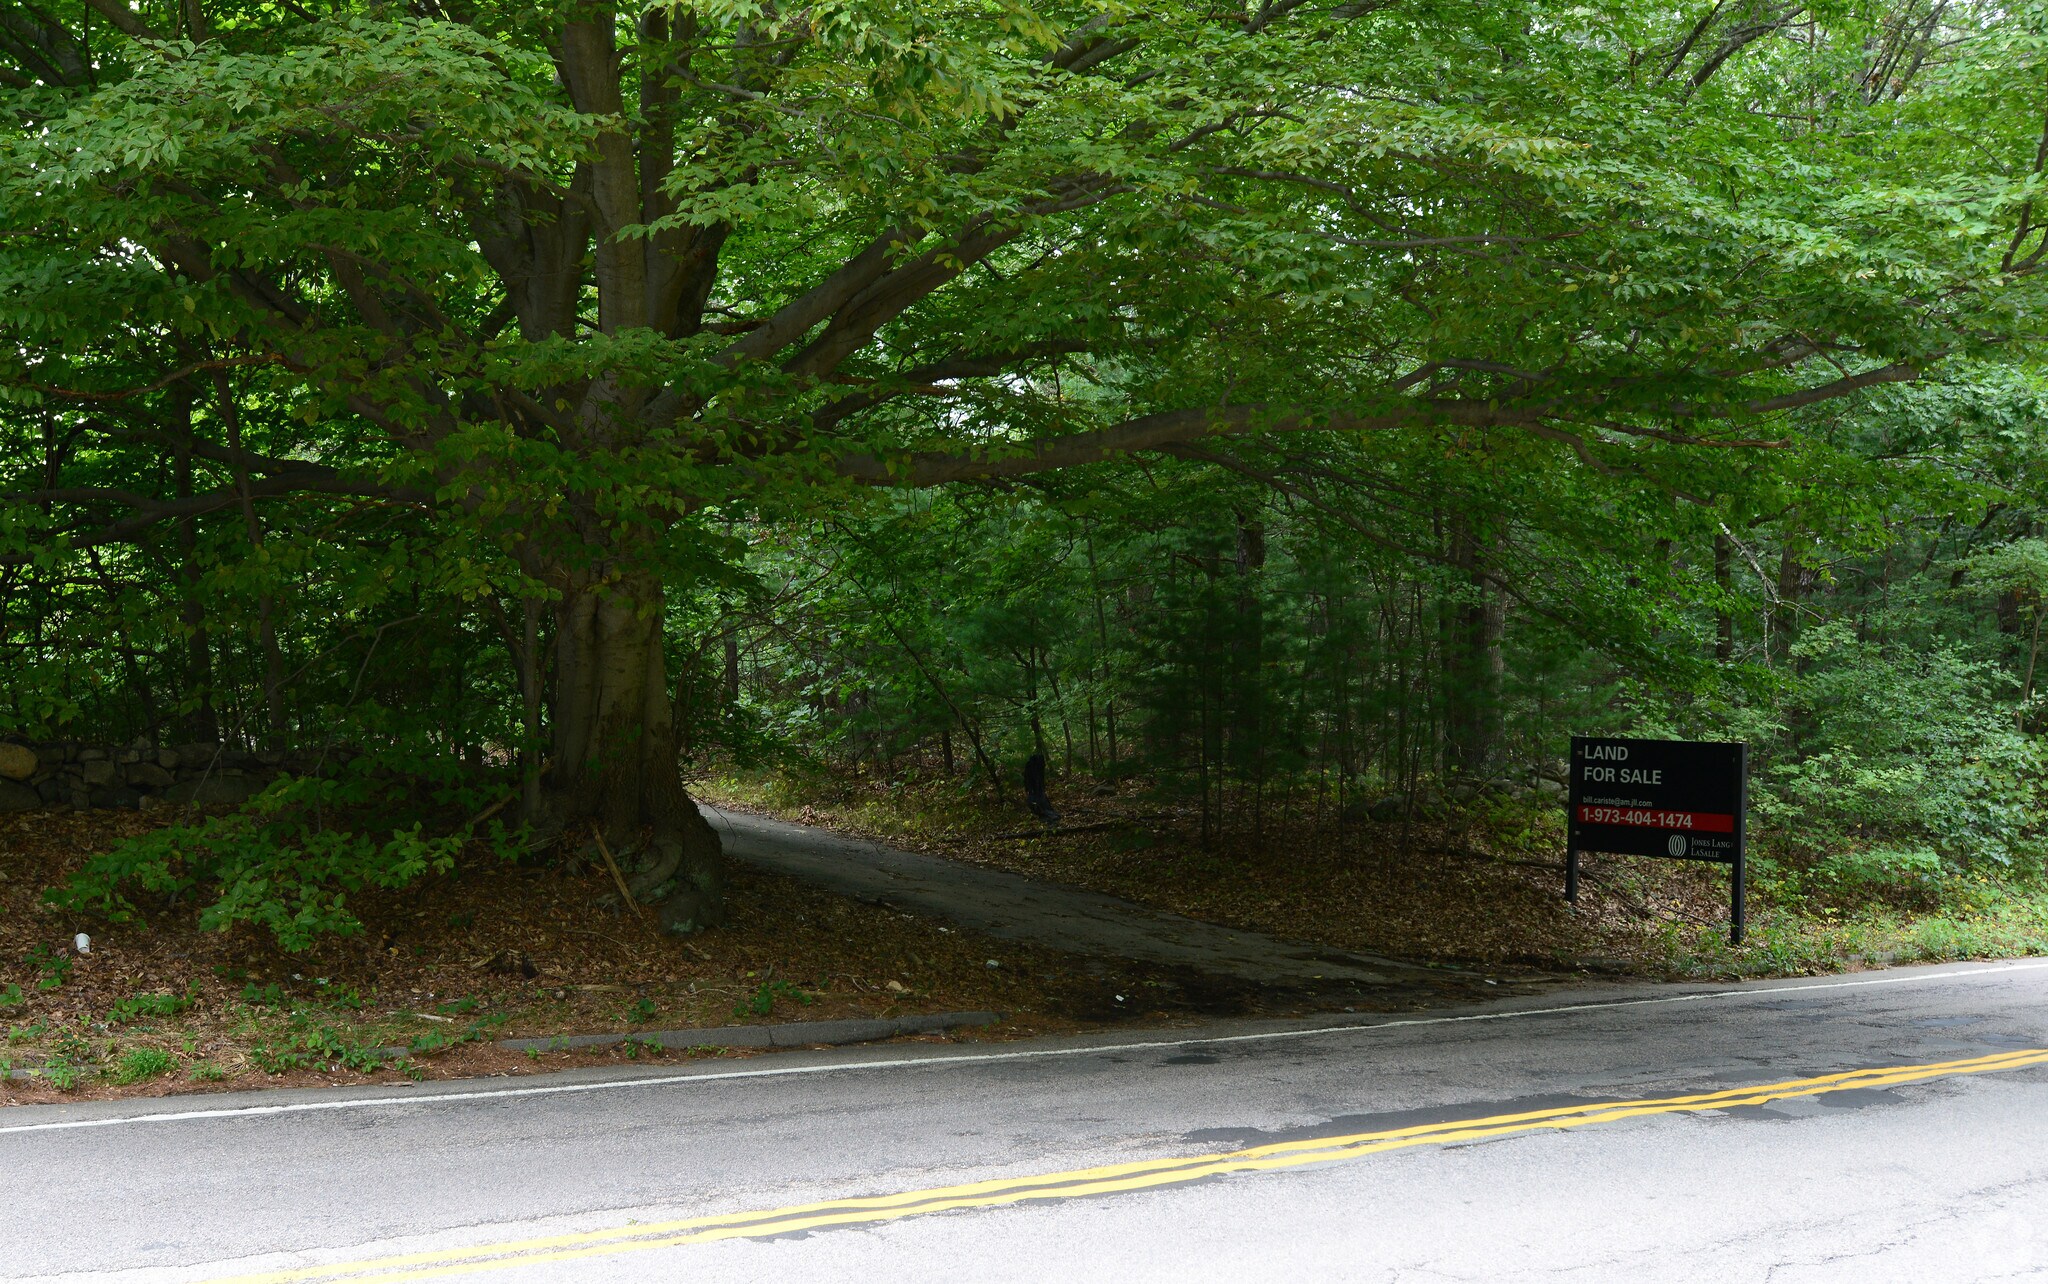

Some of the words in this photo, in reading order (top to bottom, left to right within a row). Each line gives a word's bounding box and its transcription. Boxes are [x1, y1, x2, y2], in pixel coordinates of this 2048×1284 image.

[1584, 745, 1629, 761] LAND
[1584, 767, 1615, 783] FOR
[1620, 769, 1662, 785] SALE
[1583, 807, 1692, 828] 1-973-404-1474
[1691, 837, 1710, 847] JONES
[1712, 838, 1731, 848] LANG
